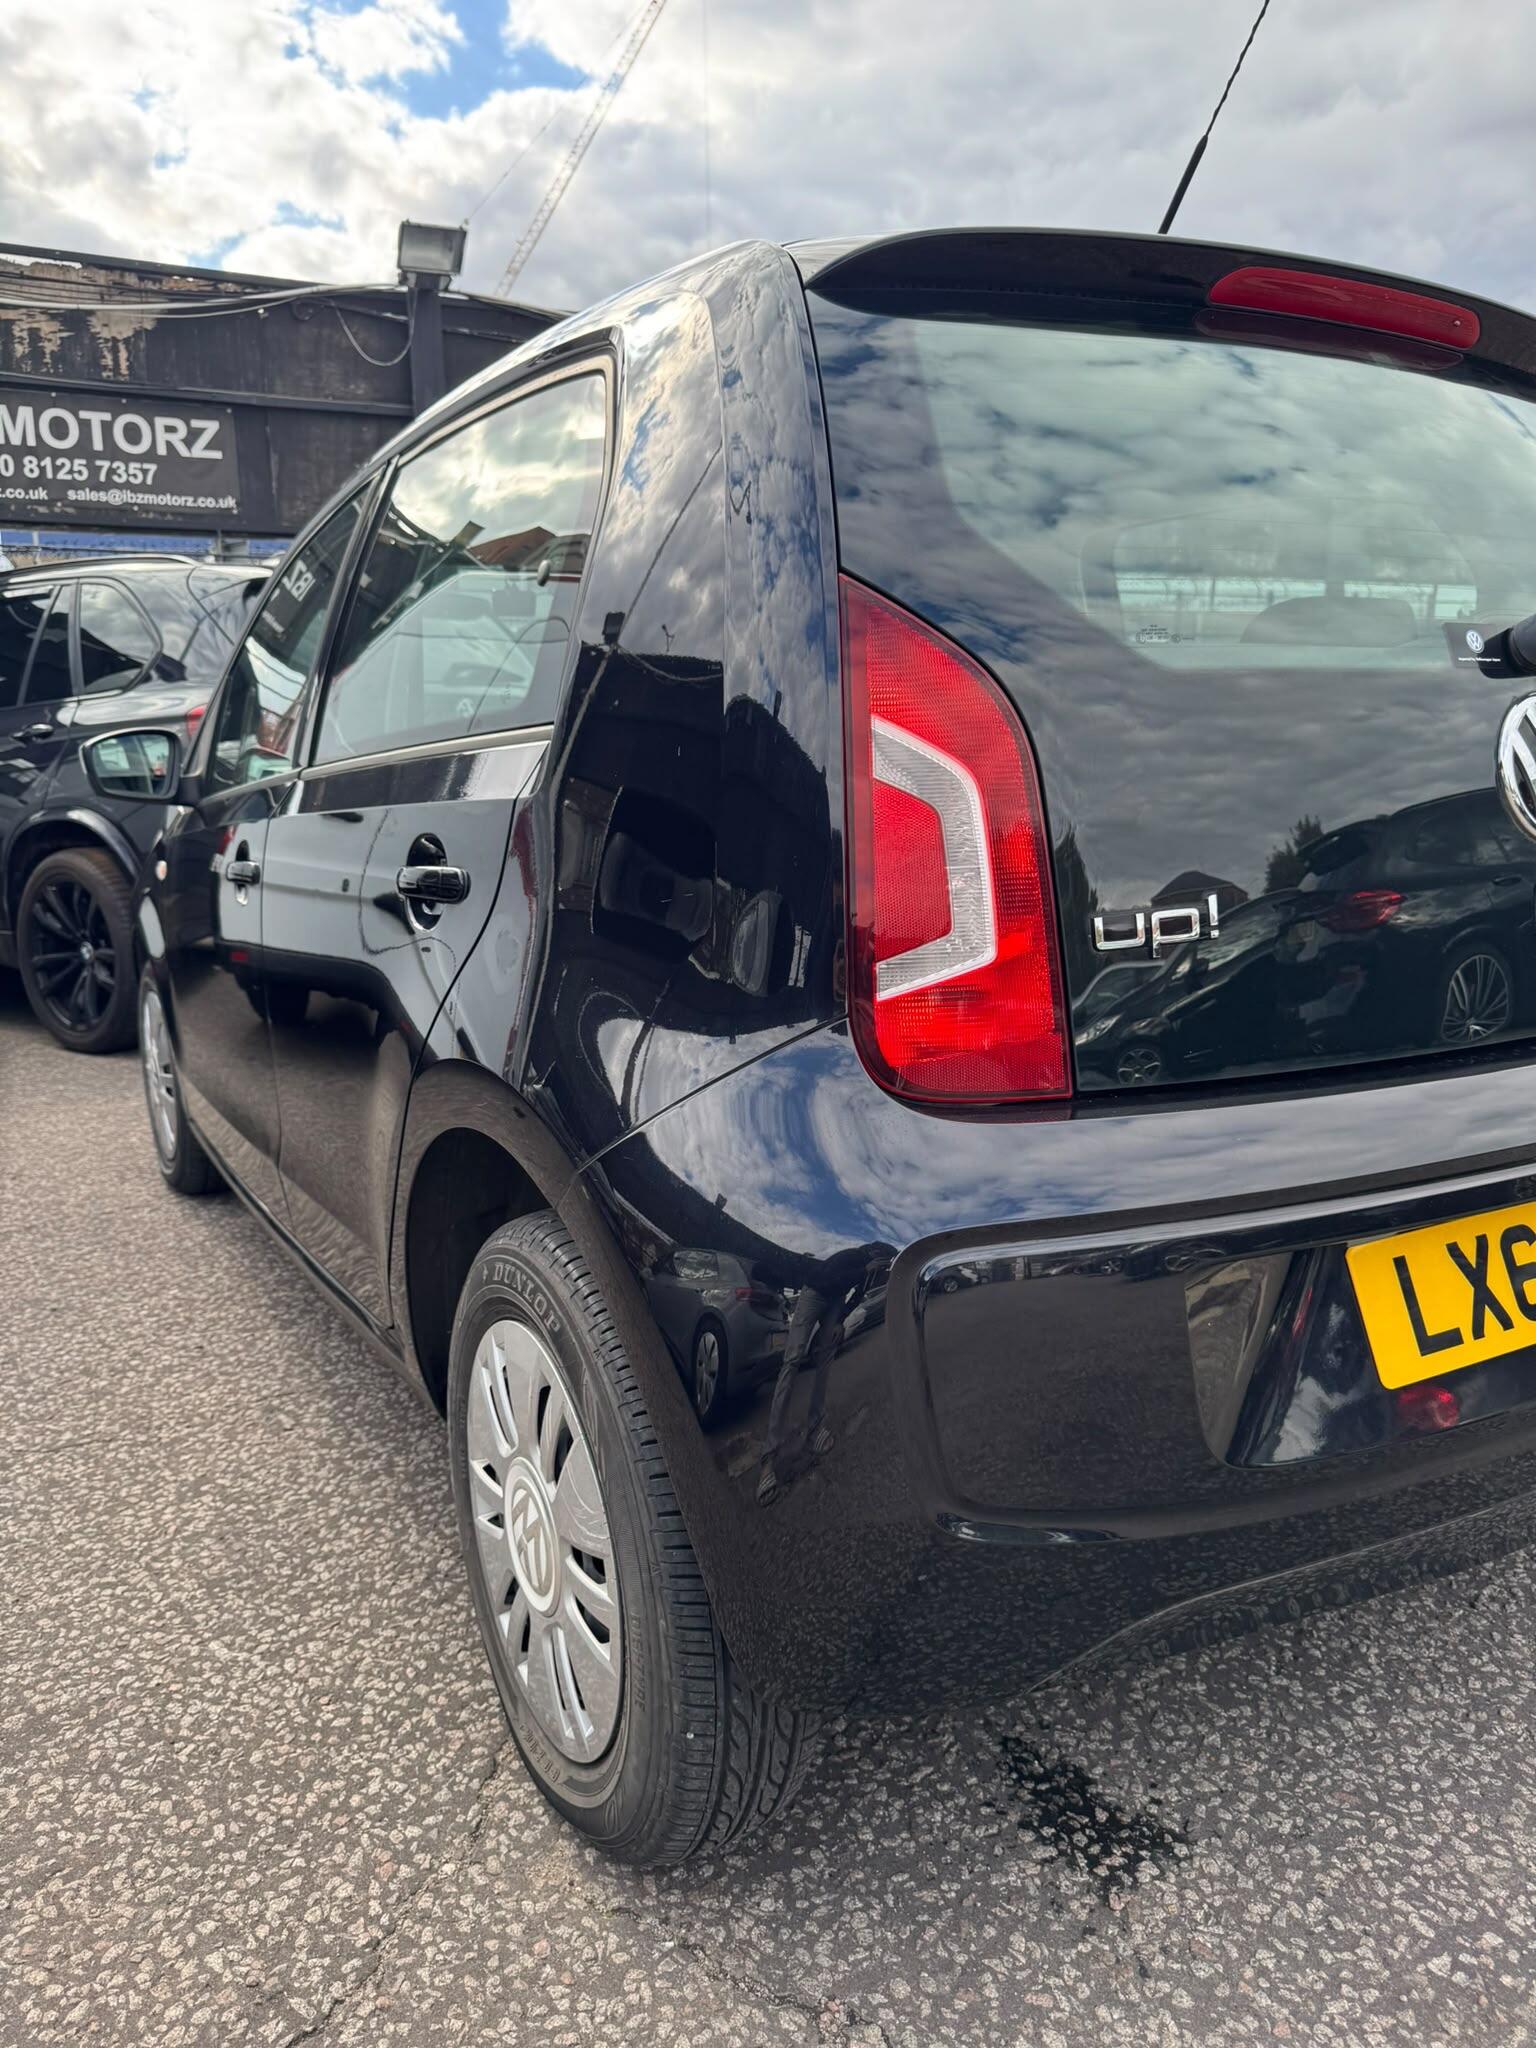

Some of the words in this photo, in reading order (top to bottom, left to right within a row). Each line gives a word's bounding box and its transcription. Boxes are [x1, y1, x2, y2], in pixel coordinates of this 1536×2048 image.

[0, 404, 223, 460] MOTORZ
[23, 455, 89, 481] 8125
[95, 460, 158, 485] 7357
[67, 487, 237, 509] sales@ibzmotorz.co.uk
[1094, 893, 1219, 958] up!
[493, 1262, 561, 1332] DUNLOP
